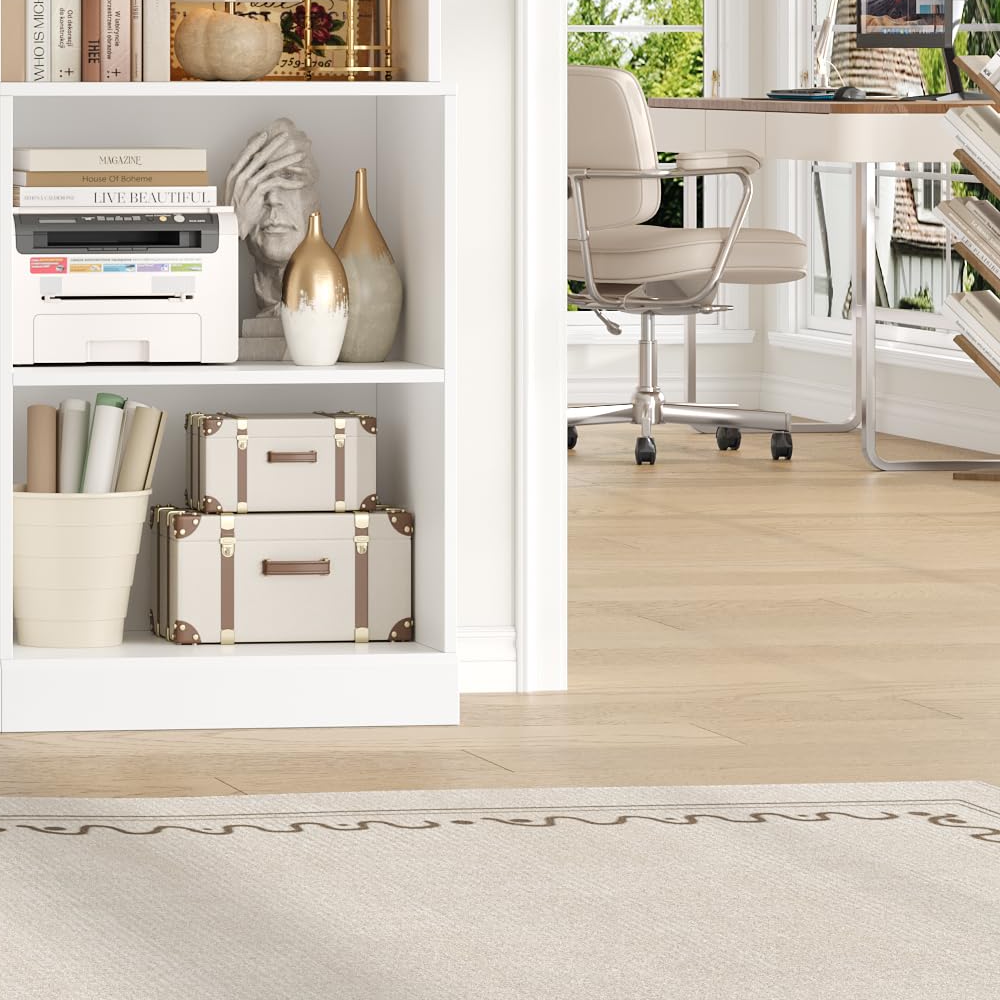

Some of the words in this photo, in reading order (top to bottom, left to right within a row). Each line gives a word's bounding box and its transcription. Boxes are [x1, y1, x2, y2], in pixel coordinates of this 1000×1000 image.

[66, 10, 73, 18] Od
[34, 32, 44, 43] IS
[113, 18, 121, 47] labiryncie
[88, 39, 100, 64] THEE
[34, 47, 44, 81] WHO
[99, 156, 142, 165] MAGAZINE
[94, 192, 126, 204] LIVE
[130, 192, 210, 204] BEAUTIFUL
